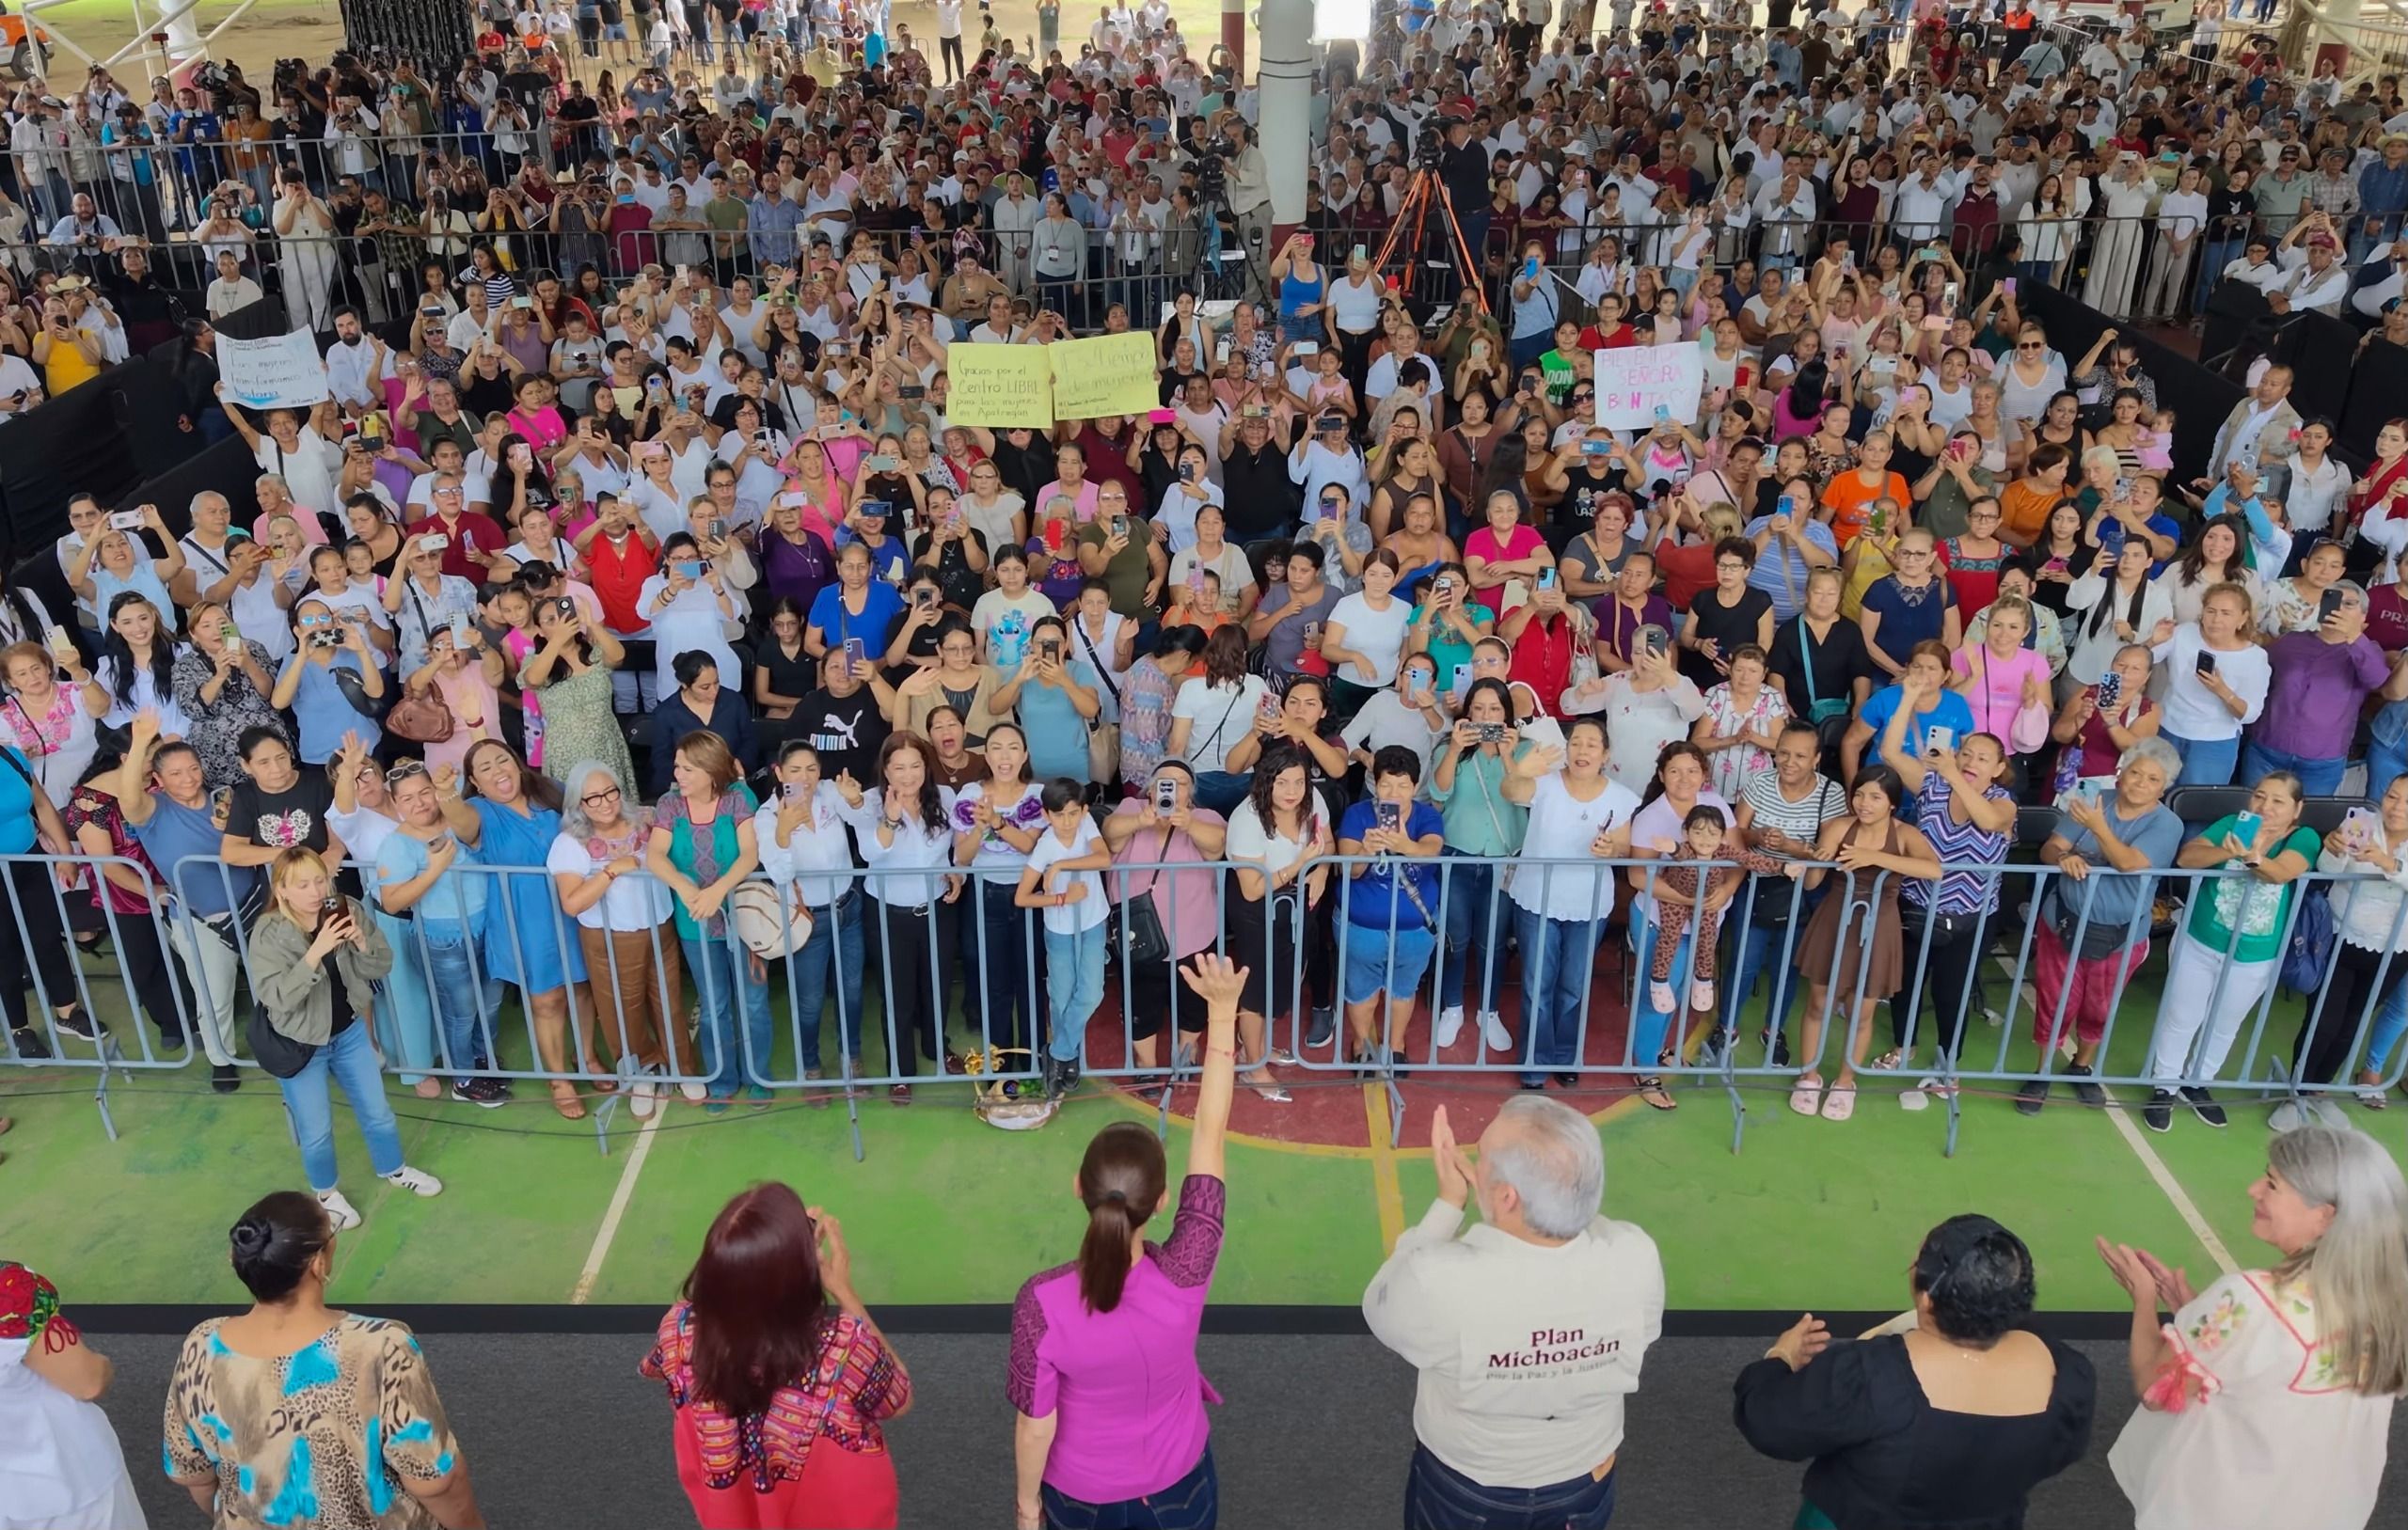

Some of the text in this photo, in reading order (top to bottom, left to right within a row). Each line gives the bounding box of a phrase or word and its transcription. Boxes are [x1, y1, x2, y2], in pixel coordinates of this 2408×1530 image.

[958, 358, 1026, 380] Gracias por el
[958, 379, 1002, 394] Centro
[1531, 1328, 1584, 1347] Plan
[1488, 1337, 1620, 1367] Michoacán
